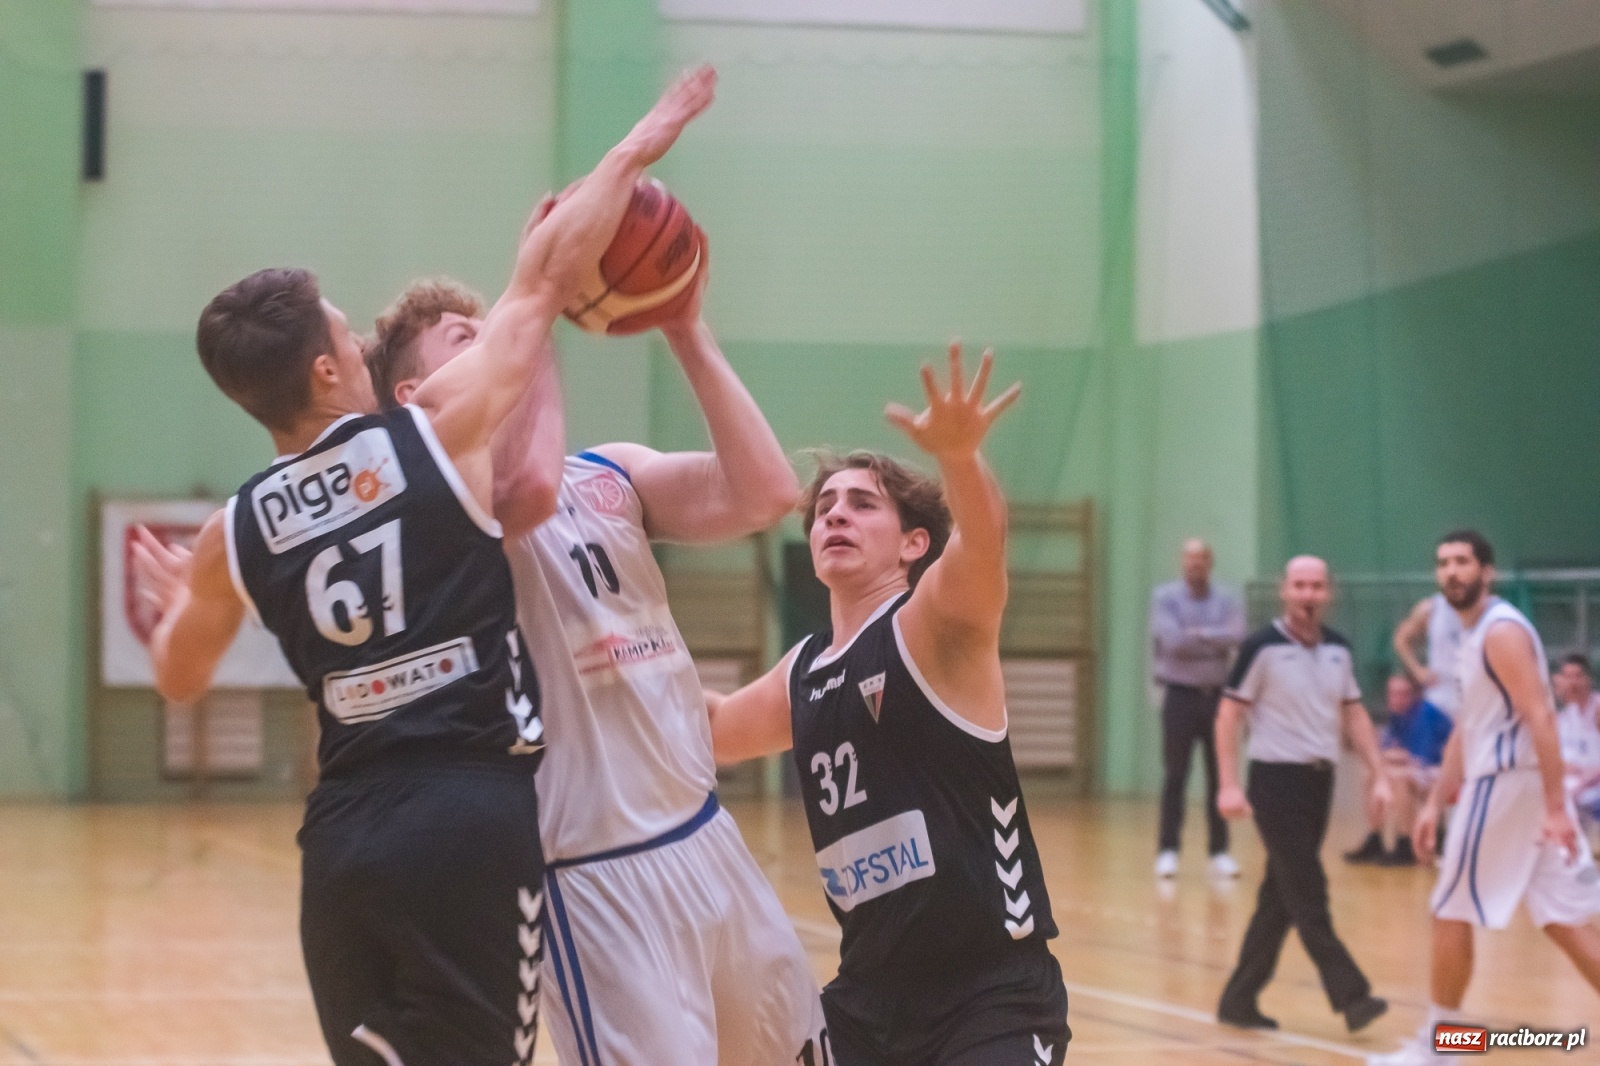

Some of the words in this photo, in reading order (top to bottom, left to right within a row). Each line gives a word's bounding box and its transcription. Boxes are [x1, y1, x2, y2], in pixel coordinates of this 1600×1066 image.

[259, 462, 352, 538] piga
[305, 518, 407, 647] 67
[569, 543, 621, 599] 10
[810, 741, 868, 816] 32
